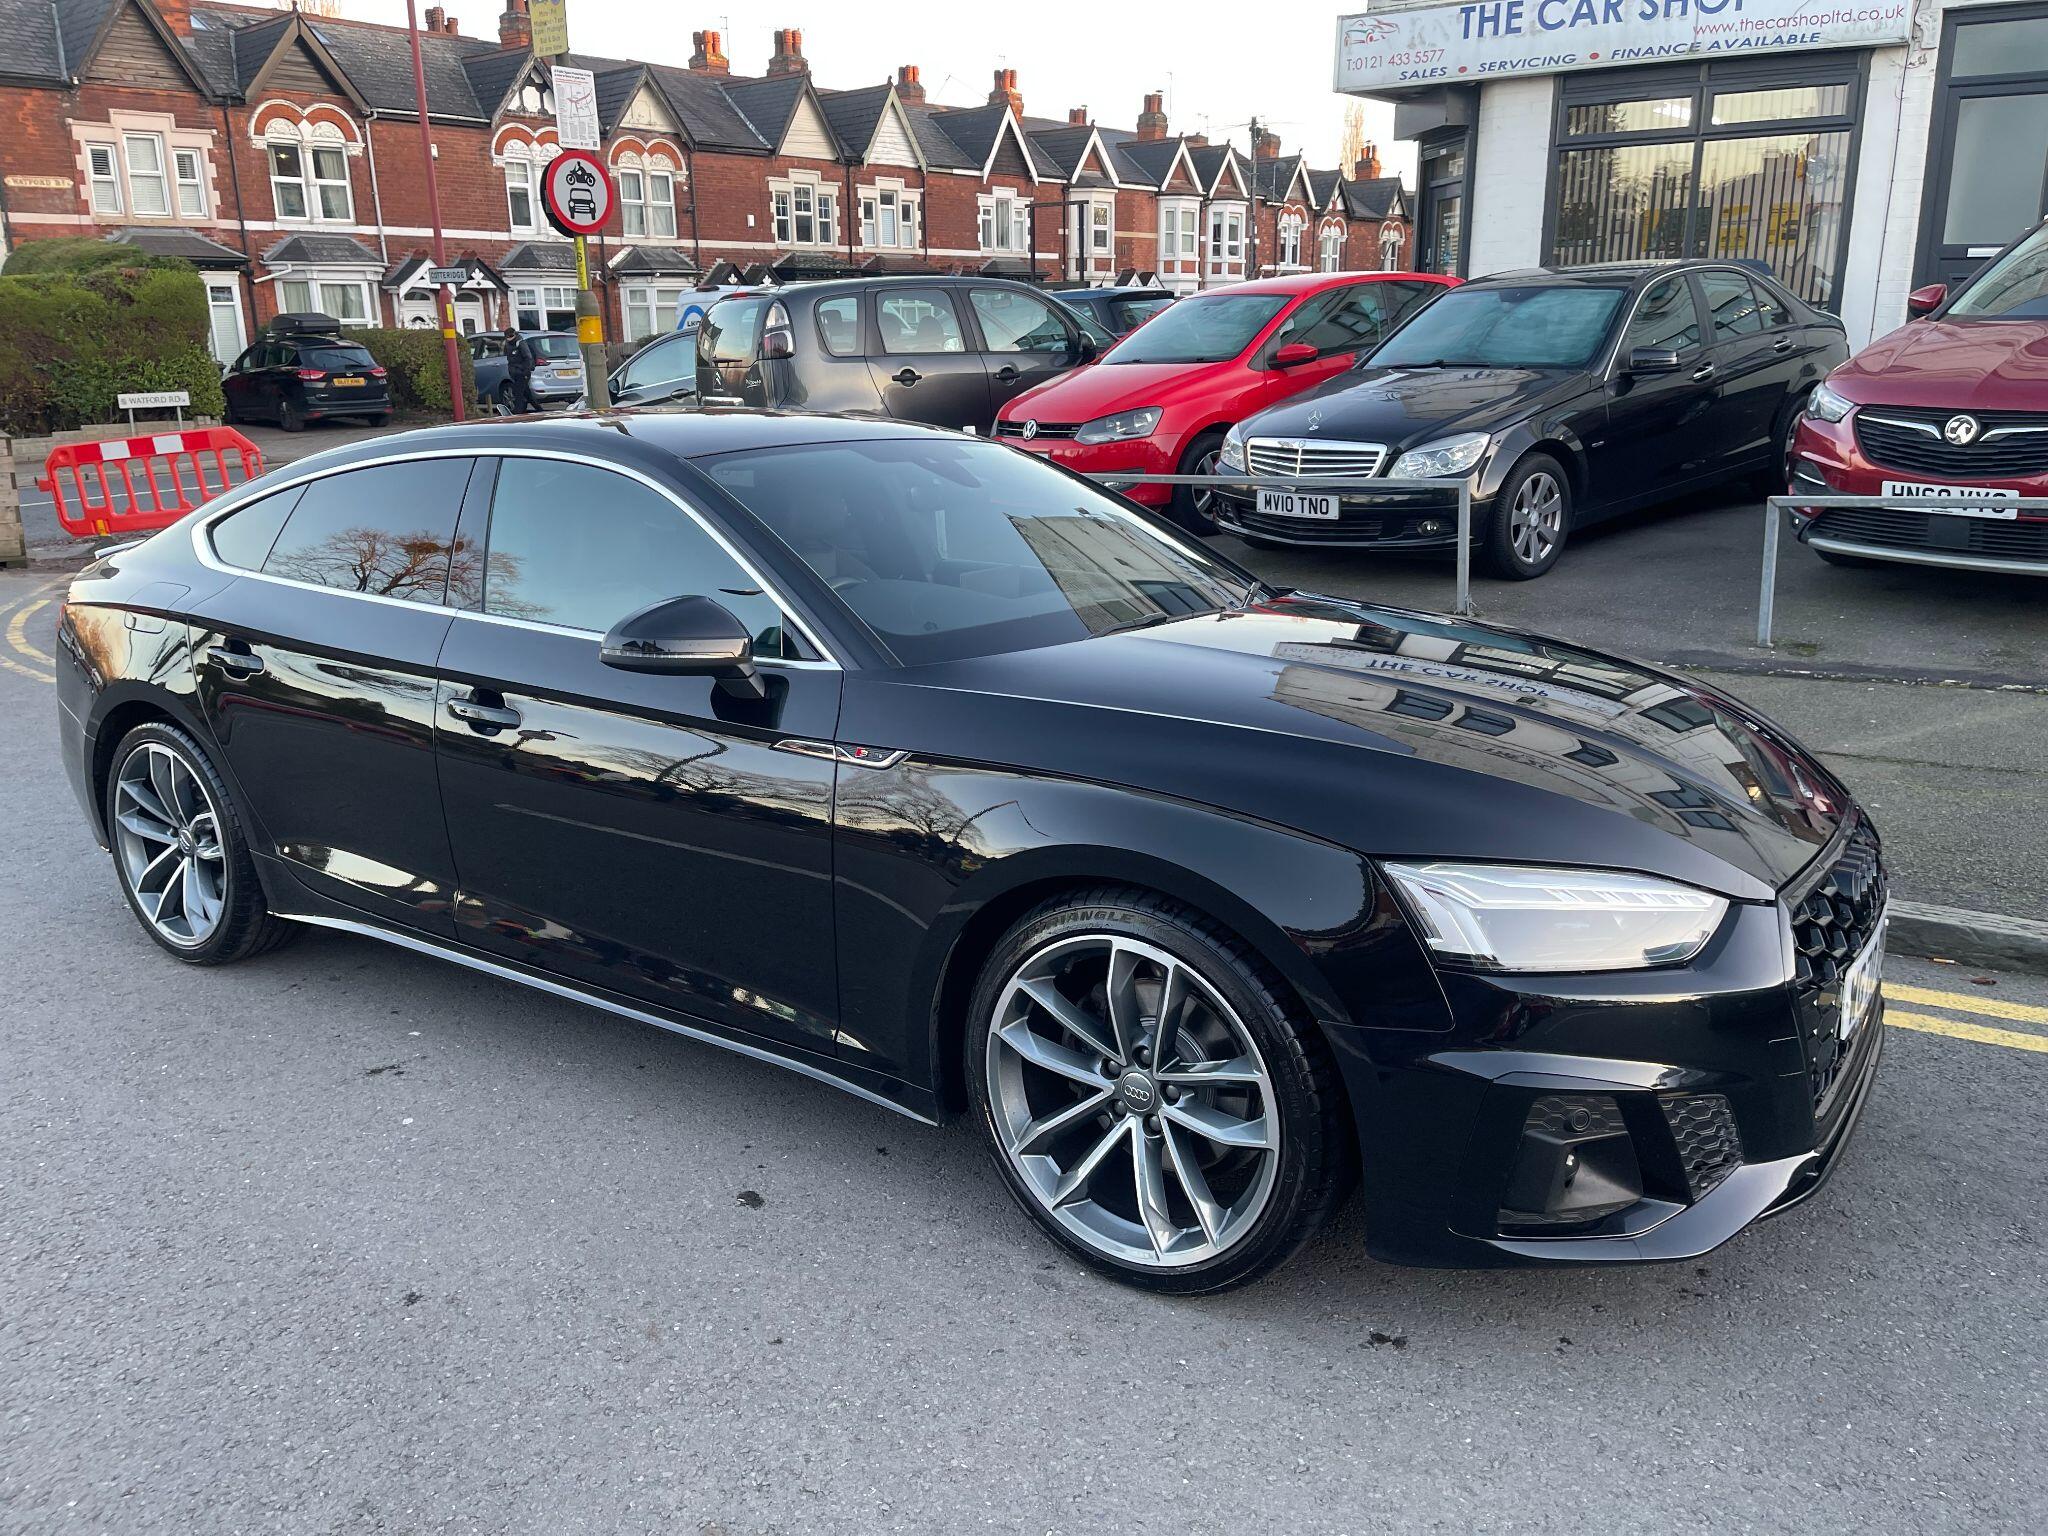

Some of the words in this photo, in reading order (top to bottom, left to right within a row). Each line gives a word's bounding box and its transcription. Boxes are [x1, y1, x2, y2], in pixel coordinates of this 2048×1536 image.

[1459, 1, 1524, 40] THE
[1537, 0, 1623, 31] CAR
[1692, 4, 1905, 36] www.thecarshopltd.co.uk
[1346, 55, 1383, 71] T:0121
[1387, 52, 1411, 67] 433
[1413, 49, 1445, 64] 5577
[1399, 66, 1448, 81] SALES
[1477, 53, 1577, 73] SERVICING
[1610, 41, 1701, 60] FINANCE
[1706, 31, 1822, 51] AVAILABLE
[12, 178, 51, 186] WATFORD
[128, 396, 167, 405] WATFORD
[168, 395, 181, 403] RD
[1264, 493, 1294, 513] MV10
[1297, 496, 1330, 515] TNO
